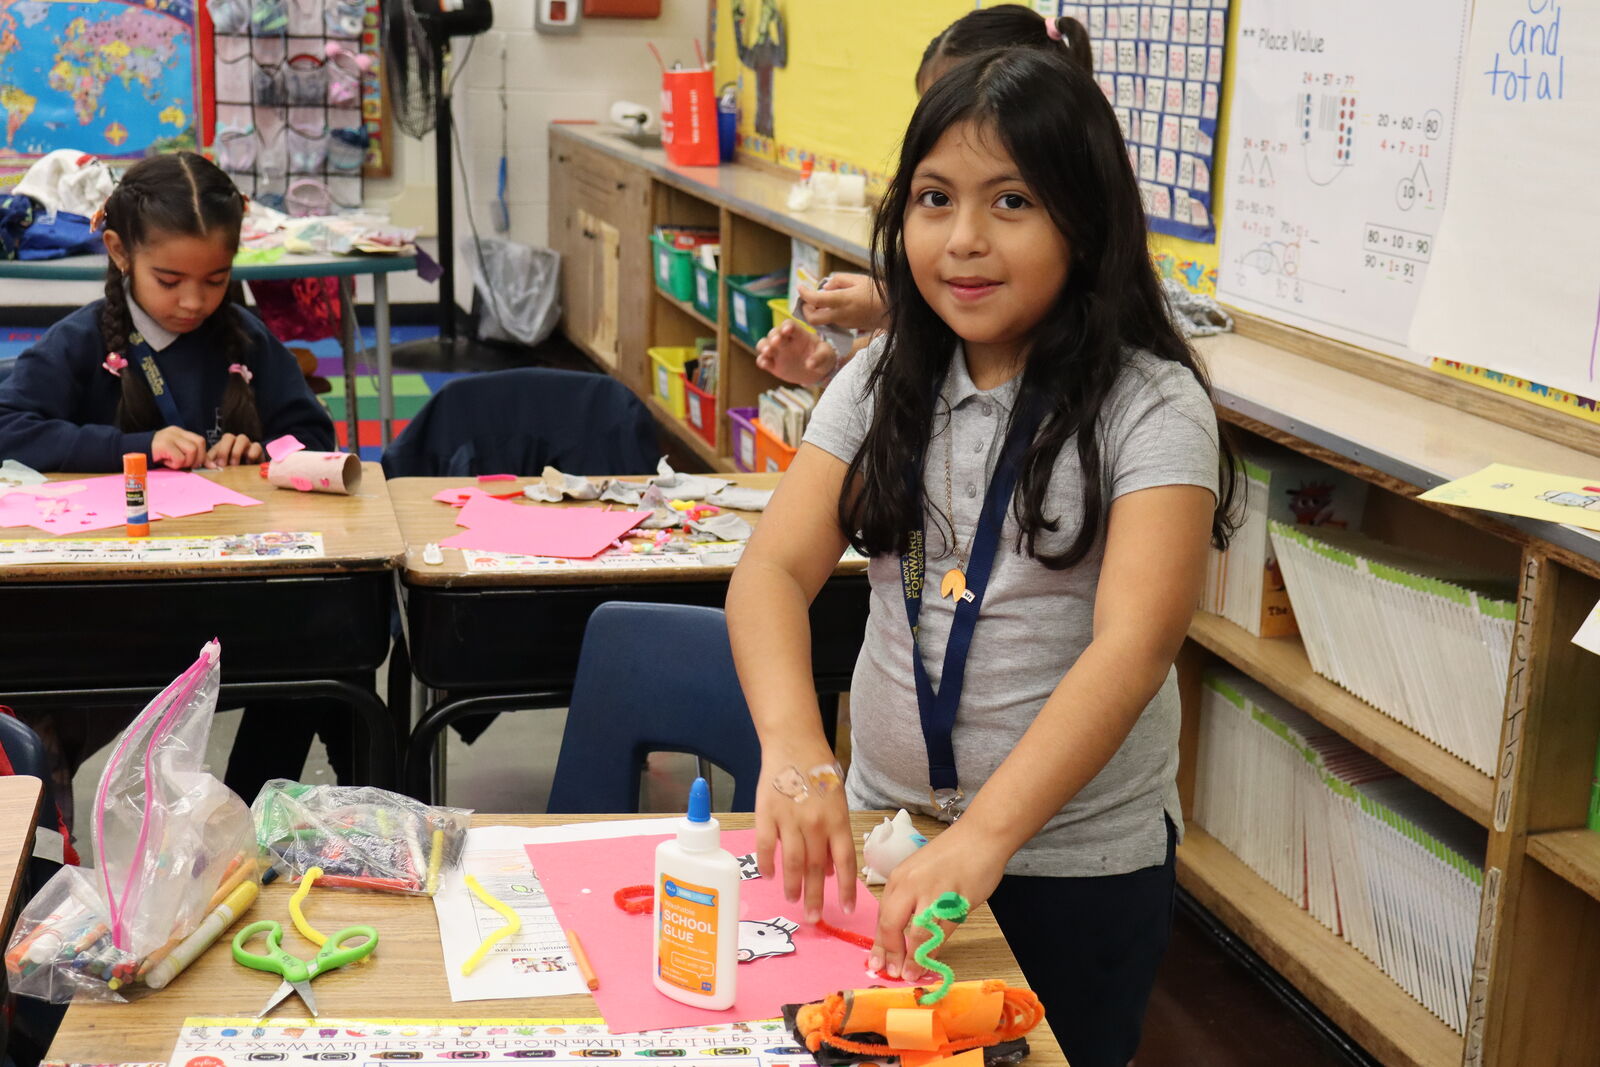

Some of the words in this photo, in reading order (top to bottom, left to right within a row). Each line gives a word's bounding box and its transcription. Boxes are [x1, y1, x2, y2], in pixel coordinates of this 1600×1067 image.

[1259, 28, 1288, 50] Place
[1291, 29, 1325, 53] Value
[1509, 6, 1561, 56] and
[1483, 52, 1564, 102] total
[1377, 113, 1390, 127] 20
[1401, 115, 1414, 130] 60
[1426, 118, 1439, 133] 80
[1380, 139, 1388, 149] 4
[1399, 141, 1406, 153] 7
[1418, 144, 1429, 158] 11
[1402, 184, 1415, 199] 10
[1367, 229, 1380, 244] 80
[1392, 234, 1404, 249] 10
[1416, 239, 1429, 254] 90
[1364, 254, 1377, 268] 90
[1403, 262, 1414, 277] 91
[902, 560, 910, 584] MOVE
[906, 584, 912, 599] WE
[1497, 561, 1535, 823] FICTION
[663, 909, 716, 935] SCHOOL
[663, 923, 695, 943] GLUE
